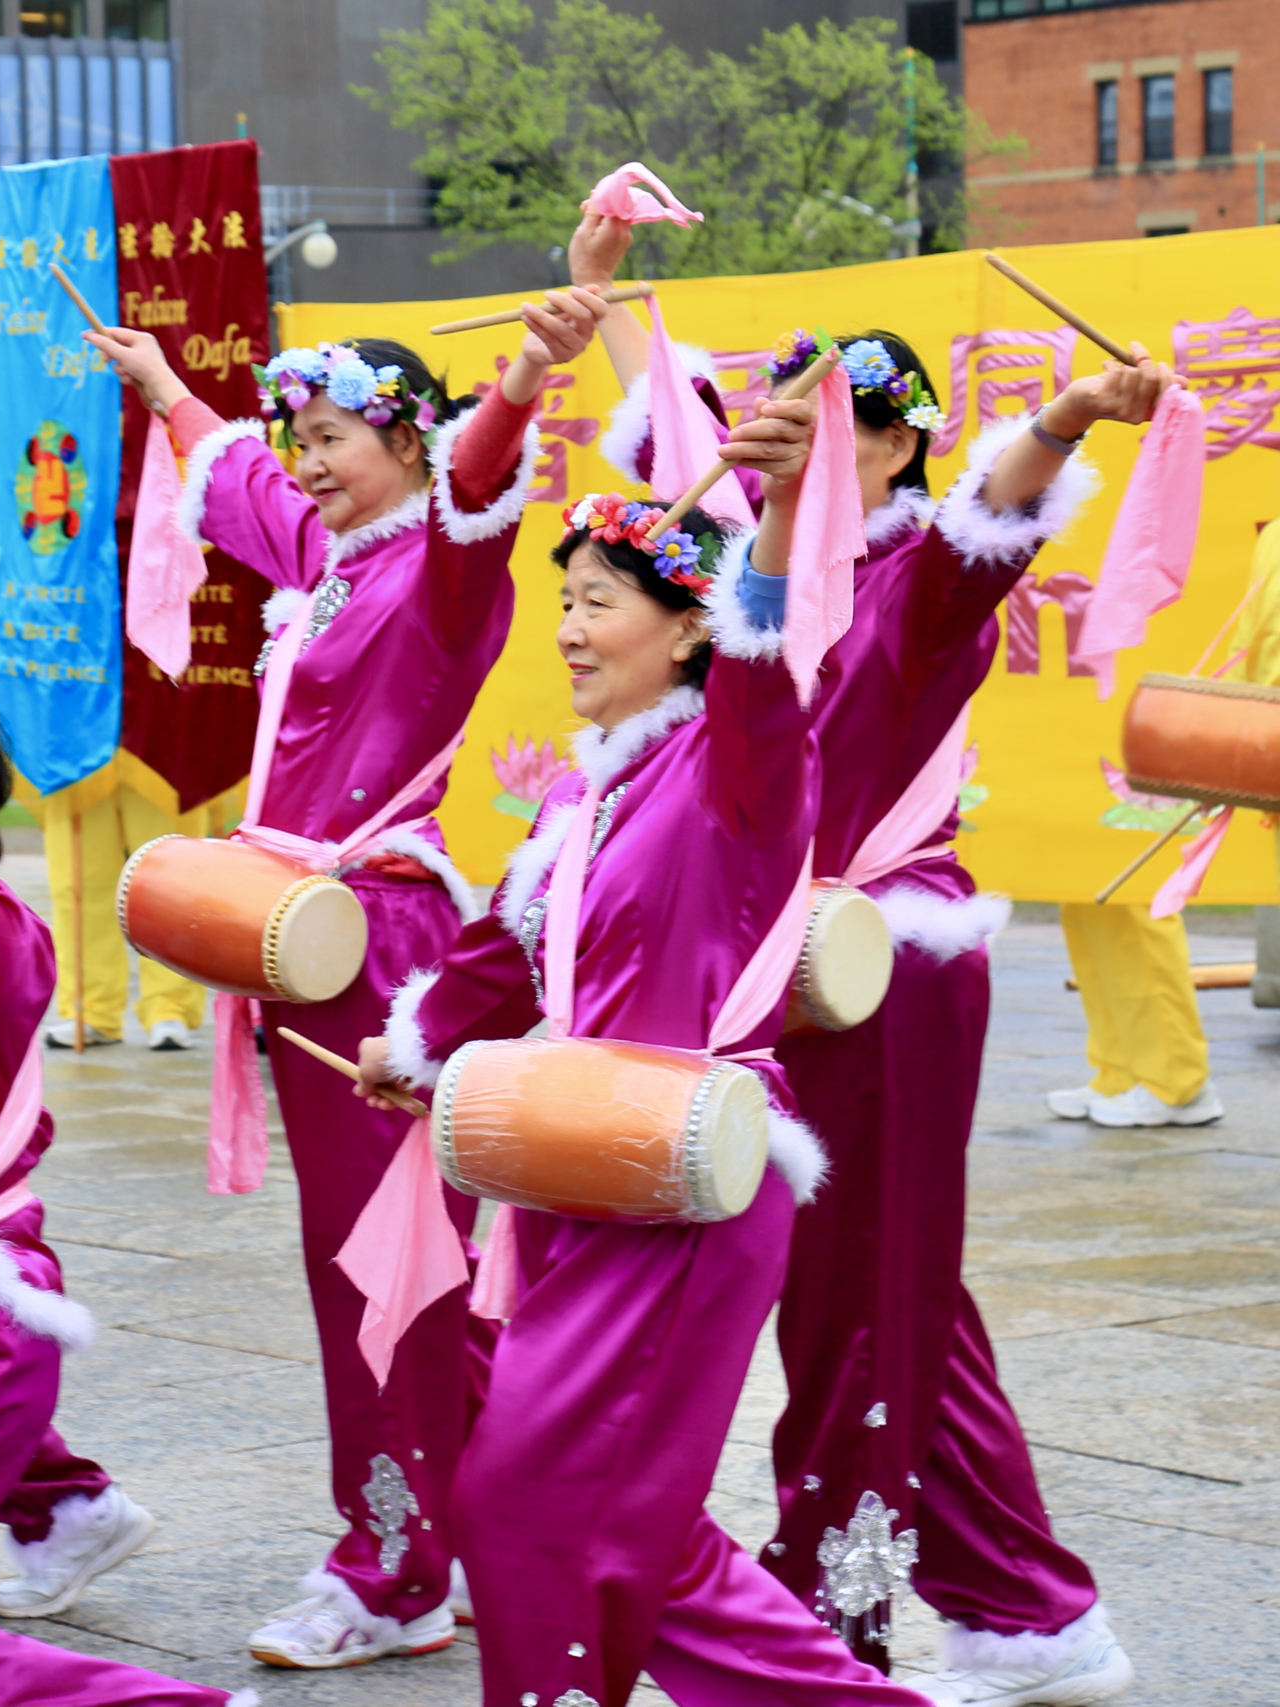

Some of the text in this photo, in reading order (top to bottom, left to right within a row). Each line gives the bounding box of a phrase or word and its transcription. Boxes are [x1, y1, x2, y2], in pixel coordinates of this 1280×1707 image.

[124, 285, 188, 328] Falun
[43, 339, 106, 390] Dafa
[182, 323, 252, 382] Dafa
